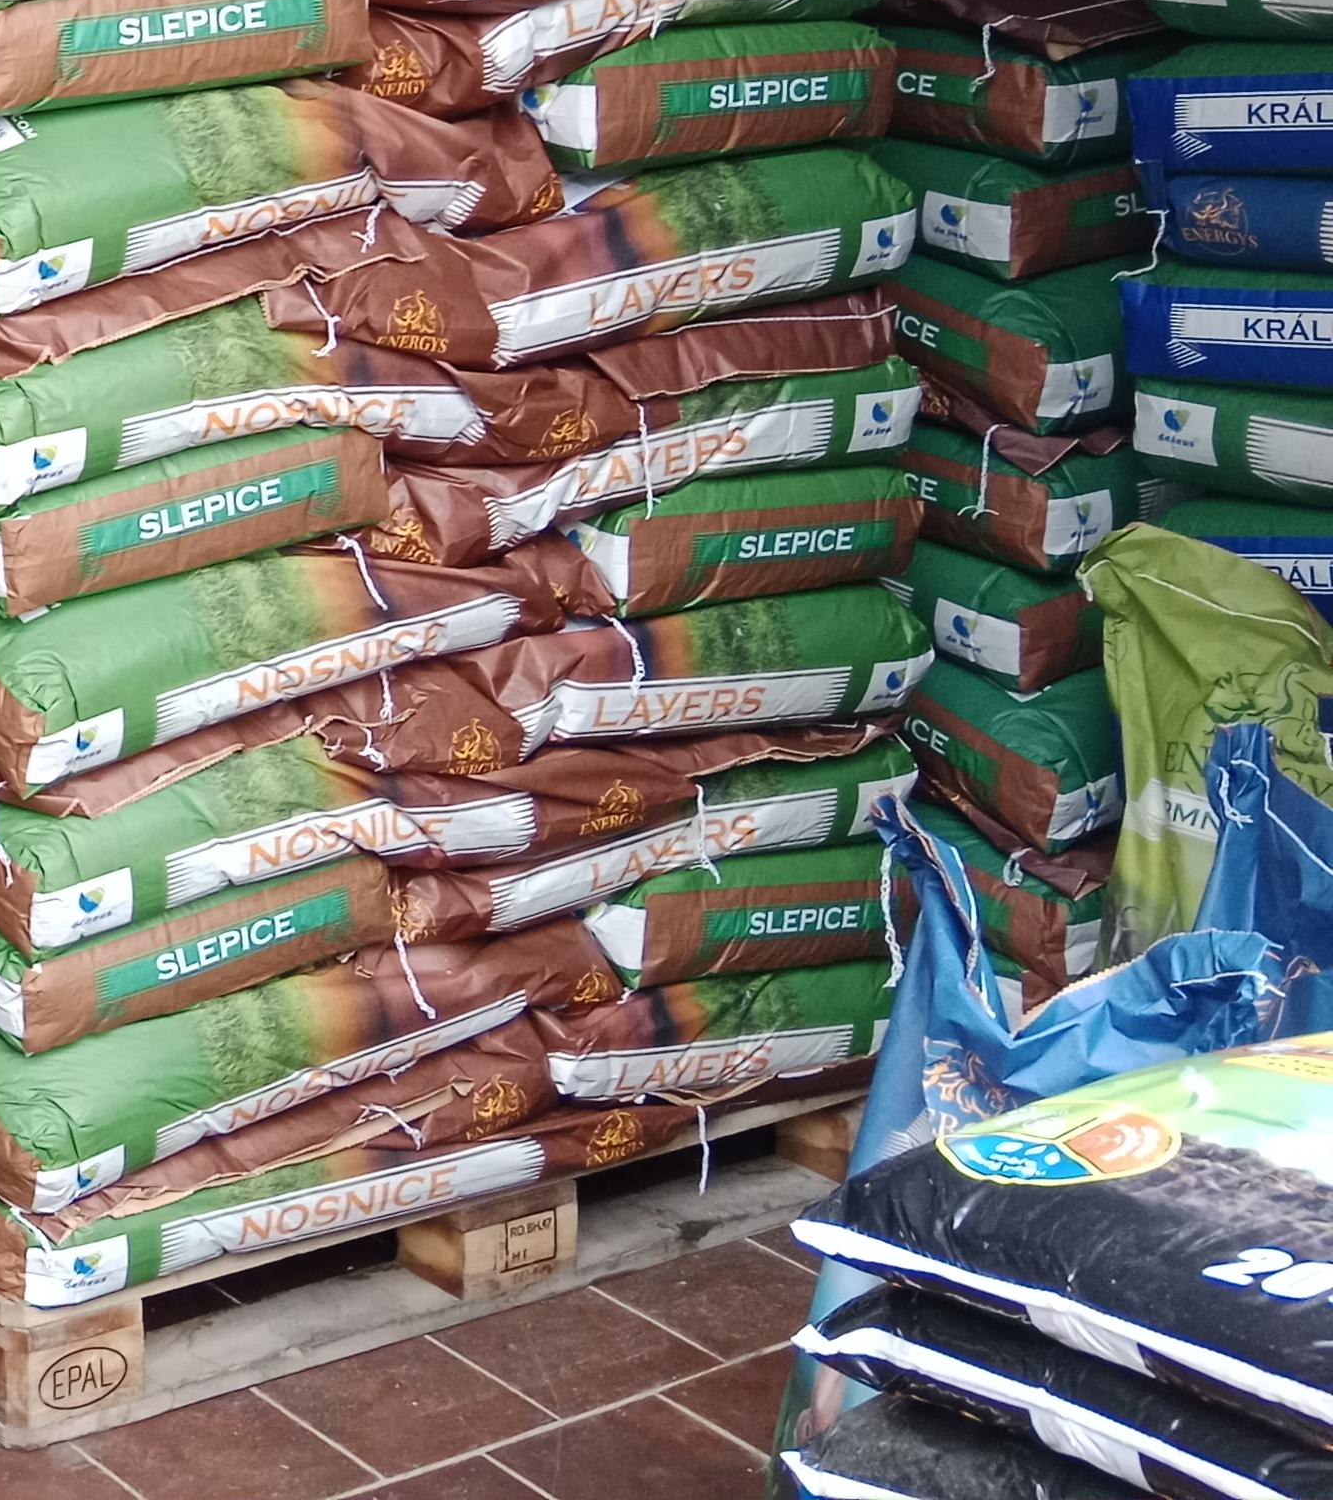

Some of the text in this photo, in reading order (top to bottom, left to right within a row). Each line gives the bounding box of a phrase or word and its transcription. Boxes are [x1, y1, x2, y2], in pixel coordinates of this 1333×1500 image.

[117, 1, 267, 46] SLEPICE
[709, 75, 828, 110] SLEPICE
[1247, 97, 1333, 125] KRÁL
[1181, 226, 1258, 250] ENERGYS
[588, 258, 757, 327] LAYERS
[377, 334, 449, 353] ENERGYS
[1243, 312, 1331, 342] KRÁL
[200, 397, 416, 440] NOSNICE
[576, 426, 749, 496] LAYERS
[138, 477, 284, 540] SLEPICE
[738, 527, 856, 560] SLEPICE
[236, 621, 449, 707] NOSNICE
[593, 686, 765, 728] LAYERS
[247, 814, 453, 875] NOSNICE
[590, 813, 757, 893] LAYERS
[749, 905, 861, 936] SLEPICE
[156, 910, 296, 981] SLEPICE
[615, 1045, 772, 1091] LAYERS
[237, 1165, 459, 1247] NOSNICE
[52, 1358, 115, 1401] EPAL
